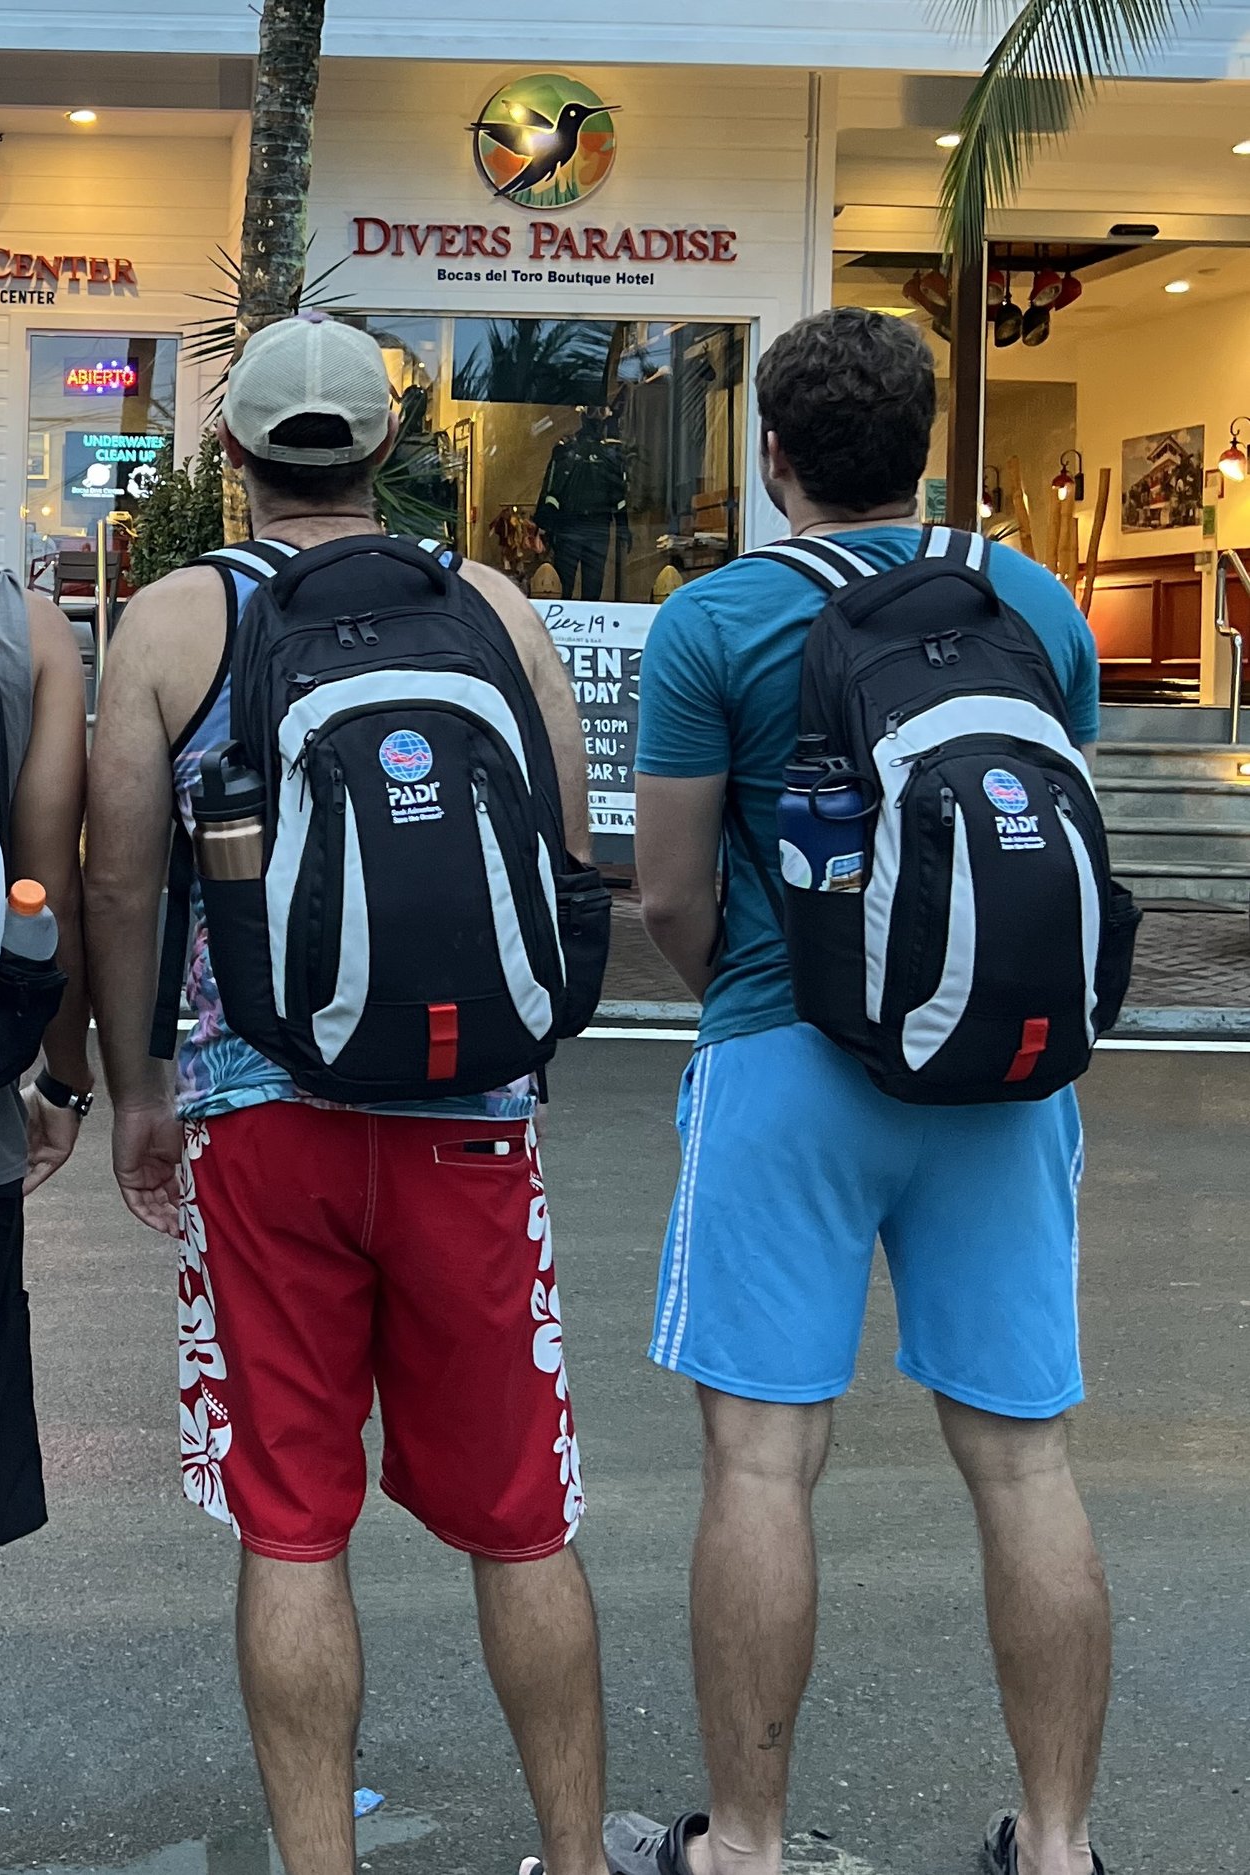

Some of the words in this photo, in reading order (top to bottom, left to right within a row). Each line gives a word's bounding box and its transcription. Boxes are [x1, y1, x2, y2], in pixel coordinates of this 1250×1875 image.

[353, 217, 511, 257] DIVERS
[528, 221, 738, 262] PARADISE
[437, 269, 481, 281] Bocas
[485, 269, 507, 282] del
[511, 270, 543, 282] Toro
[548, 271, 611, 287] Boutique
[616, 272, 654, 285] Hotel
[0, 290, 55, 304] CENTER
[66, 368, 135, 386] ABIERTO
[95, 449, 137, 462] CLEAN
[139, 450, 157, 463] UP
[544, 604, 586, 632] Pier
[588, 615, 605, 633] 19
[571, 681, 622, 704] YDAY
[594, 719, 628, 733] 10PM
[585, 737, 617, 755] ENU
[387, 782, 440, 806] PADI
[994, 815, 1039, 834] PADI
